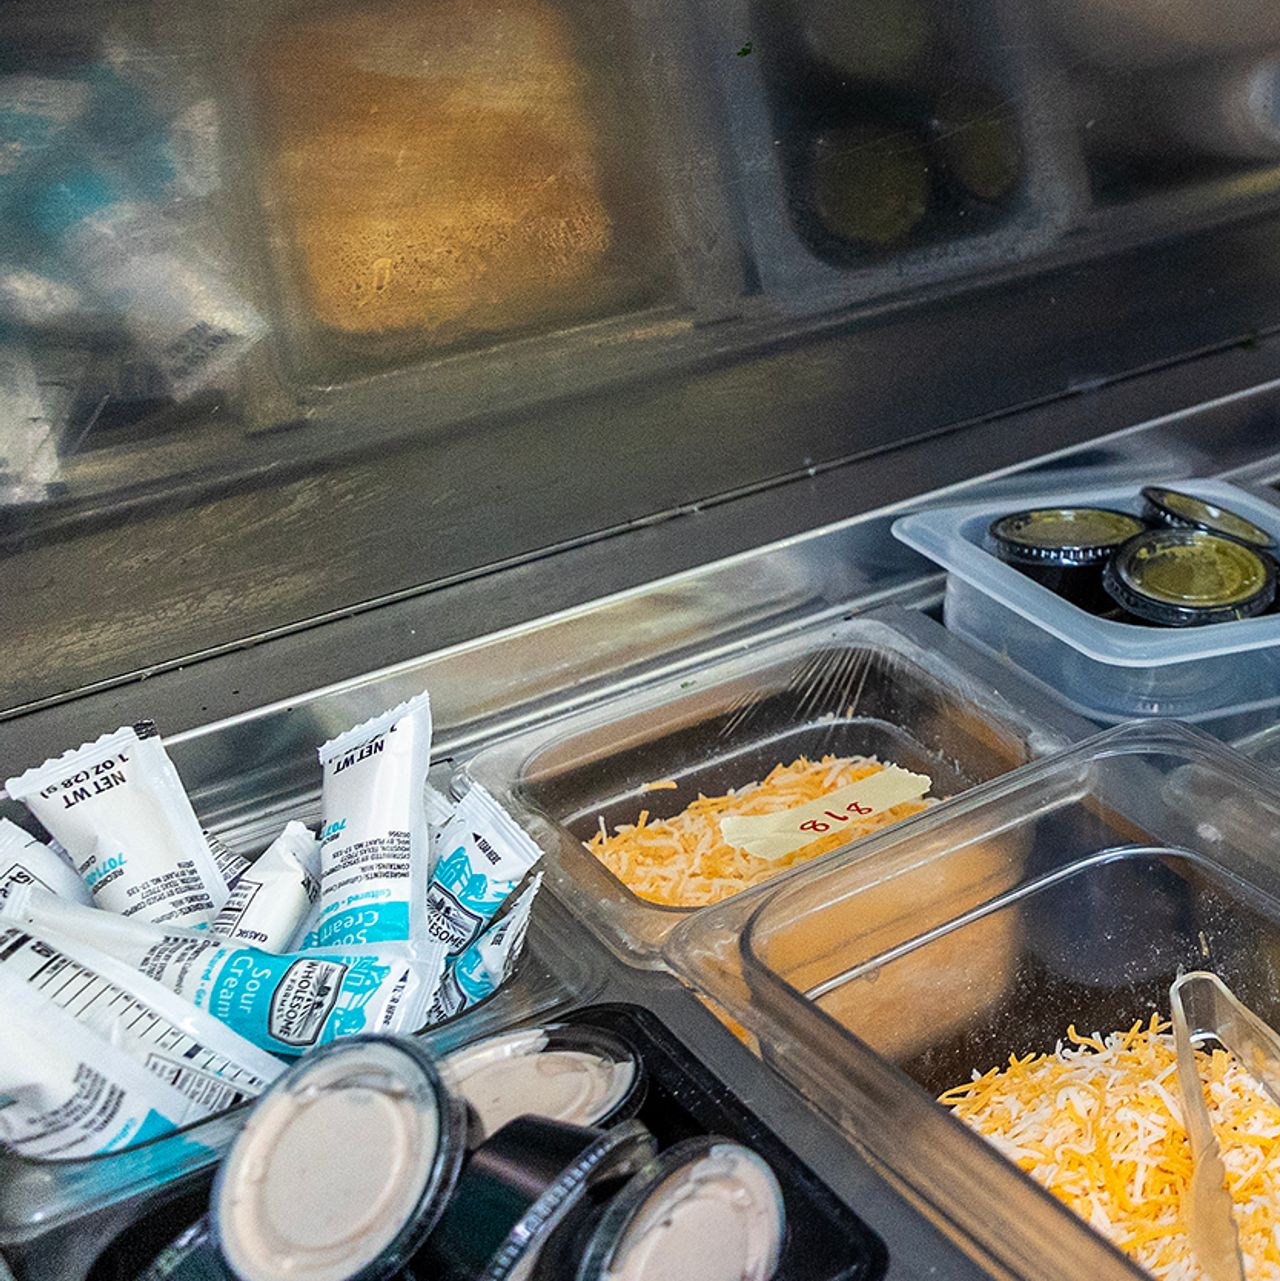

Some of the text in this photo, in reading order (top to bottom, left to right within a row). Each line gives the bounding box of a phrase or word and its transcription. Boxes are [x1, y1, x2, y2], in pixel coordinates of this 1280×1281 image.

[91, 759, 115, 775] OZ
[333, 756, 357, 774] WT
[356, 740, 386, 763] NET
[63, 770, 126, 809] NET WT
[216, 958, 252, 1017] Cream
[239, 968, 270, 1013] Sour
[279, 962, 320, 1036] WHOLESOME
